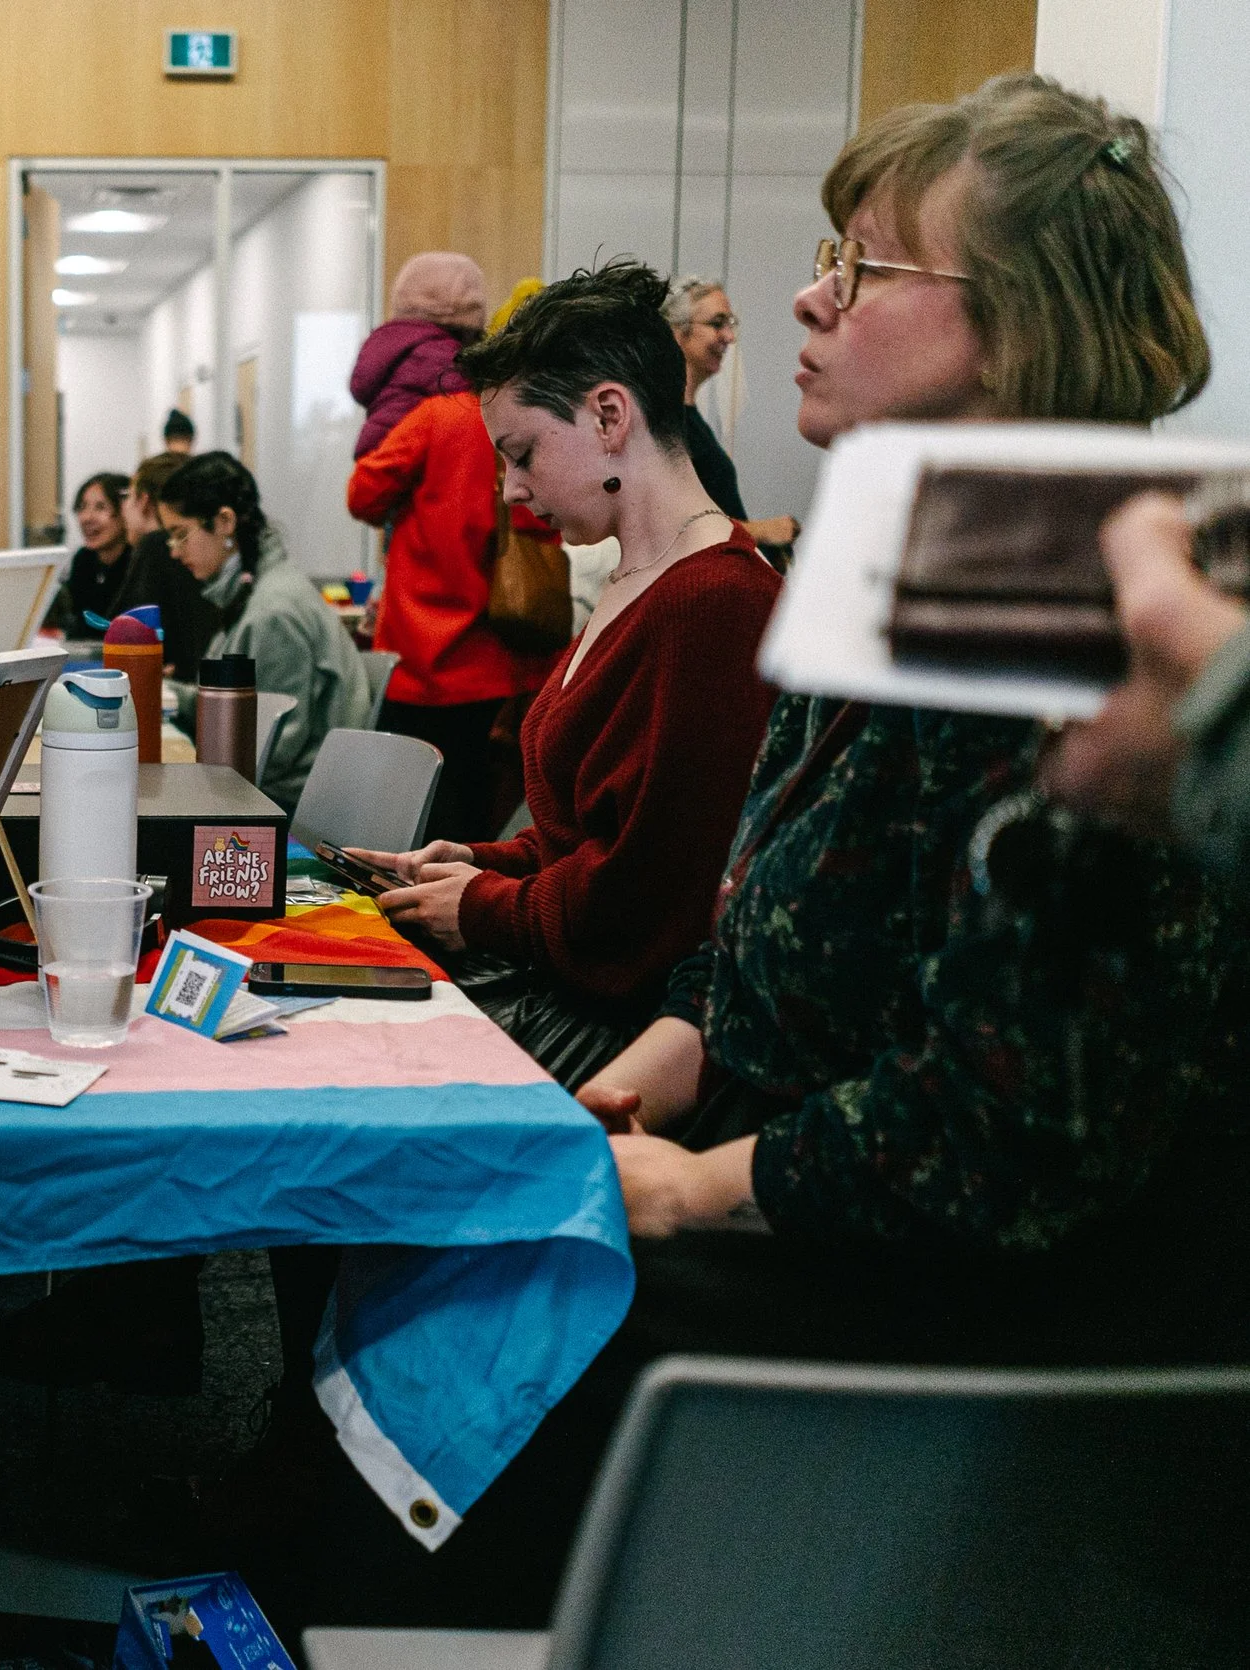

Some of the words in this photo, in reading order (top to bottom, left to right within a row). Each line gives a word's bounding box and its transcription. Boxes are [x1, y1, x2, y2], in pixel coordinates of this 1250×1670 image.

[203, 849, 234, 866] ARE
[238, 852, 260, 867] WE
[210, 882, 261, 902] NOW?
